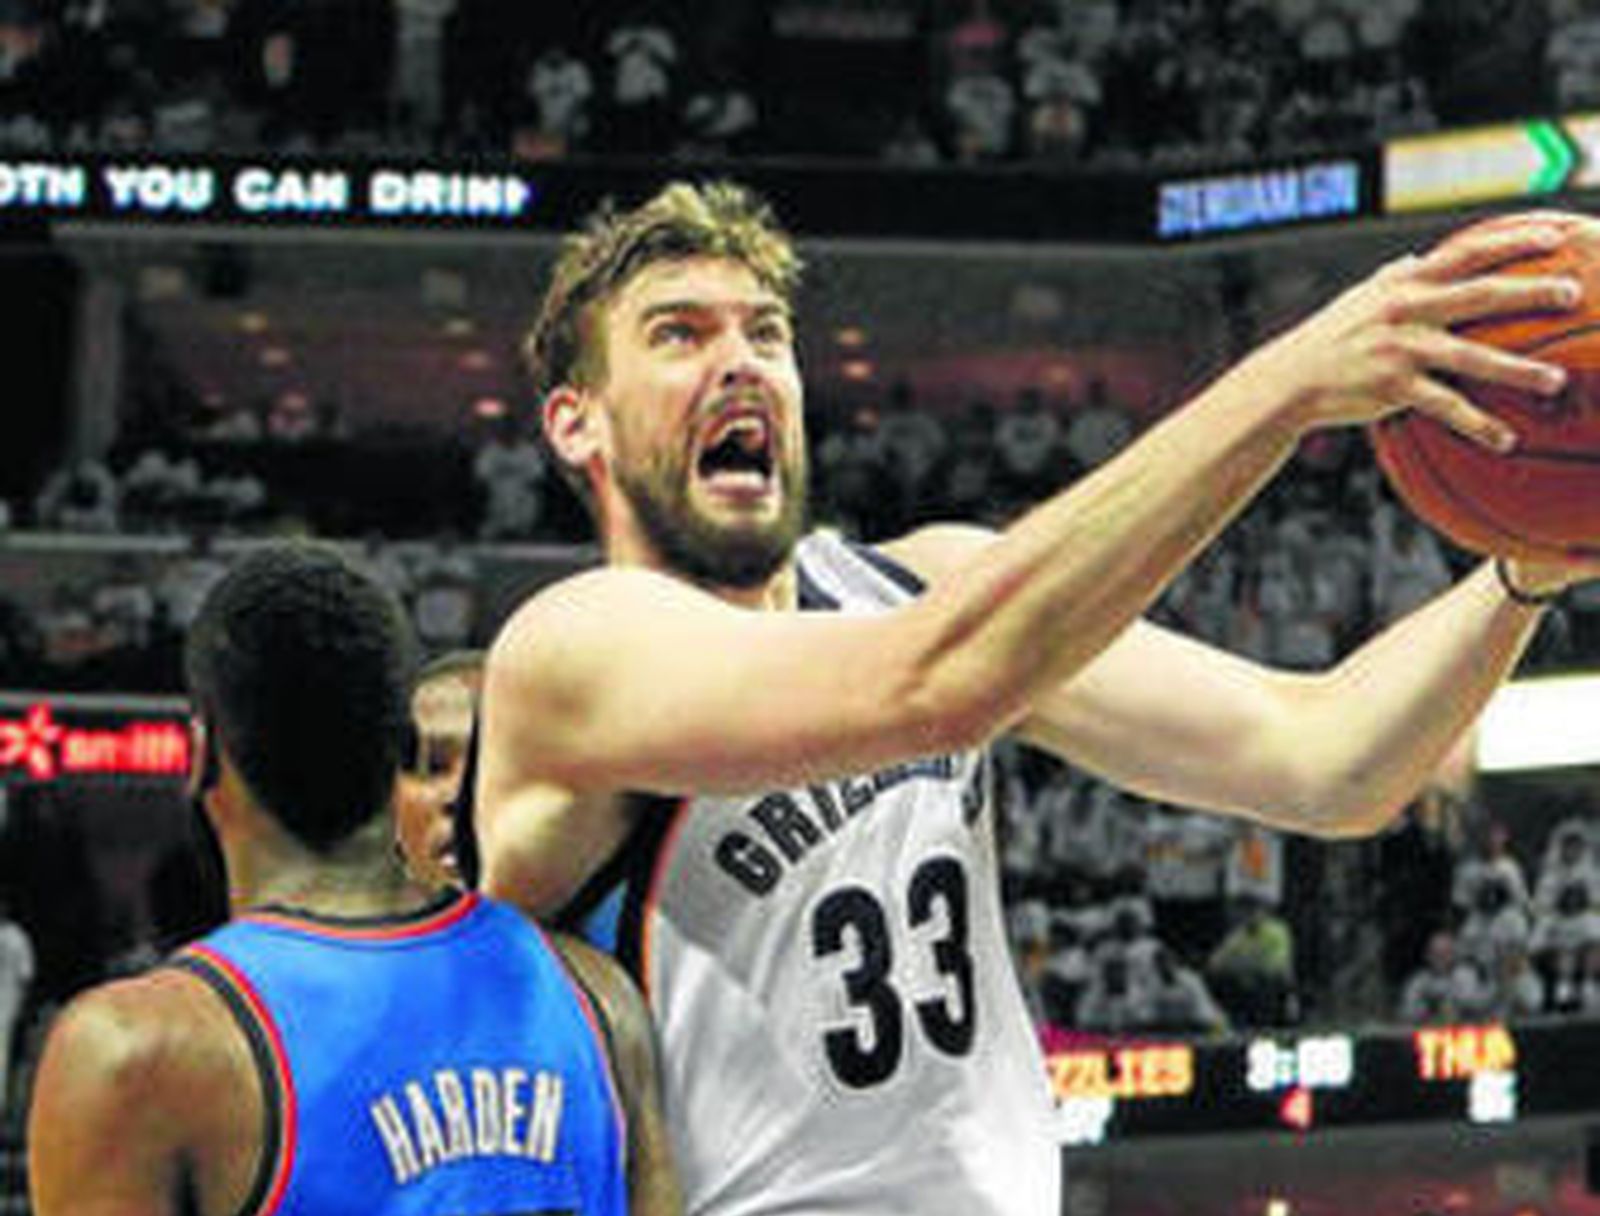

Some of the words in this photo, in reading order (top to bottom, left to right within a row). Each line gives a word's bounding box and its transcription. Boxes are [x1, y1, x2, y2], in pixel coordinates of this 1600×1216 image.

[106, 166, 214, 210] YOU
[233, 167, 349, 212] CAN
[811, 855, 976, 1090] 33
[370, 1067, 564, 1185] HARDEN
